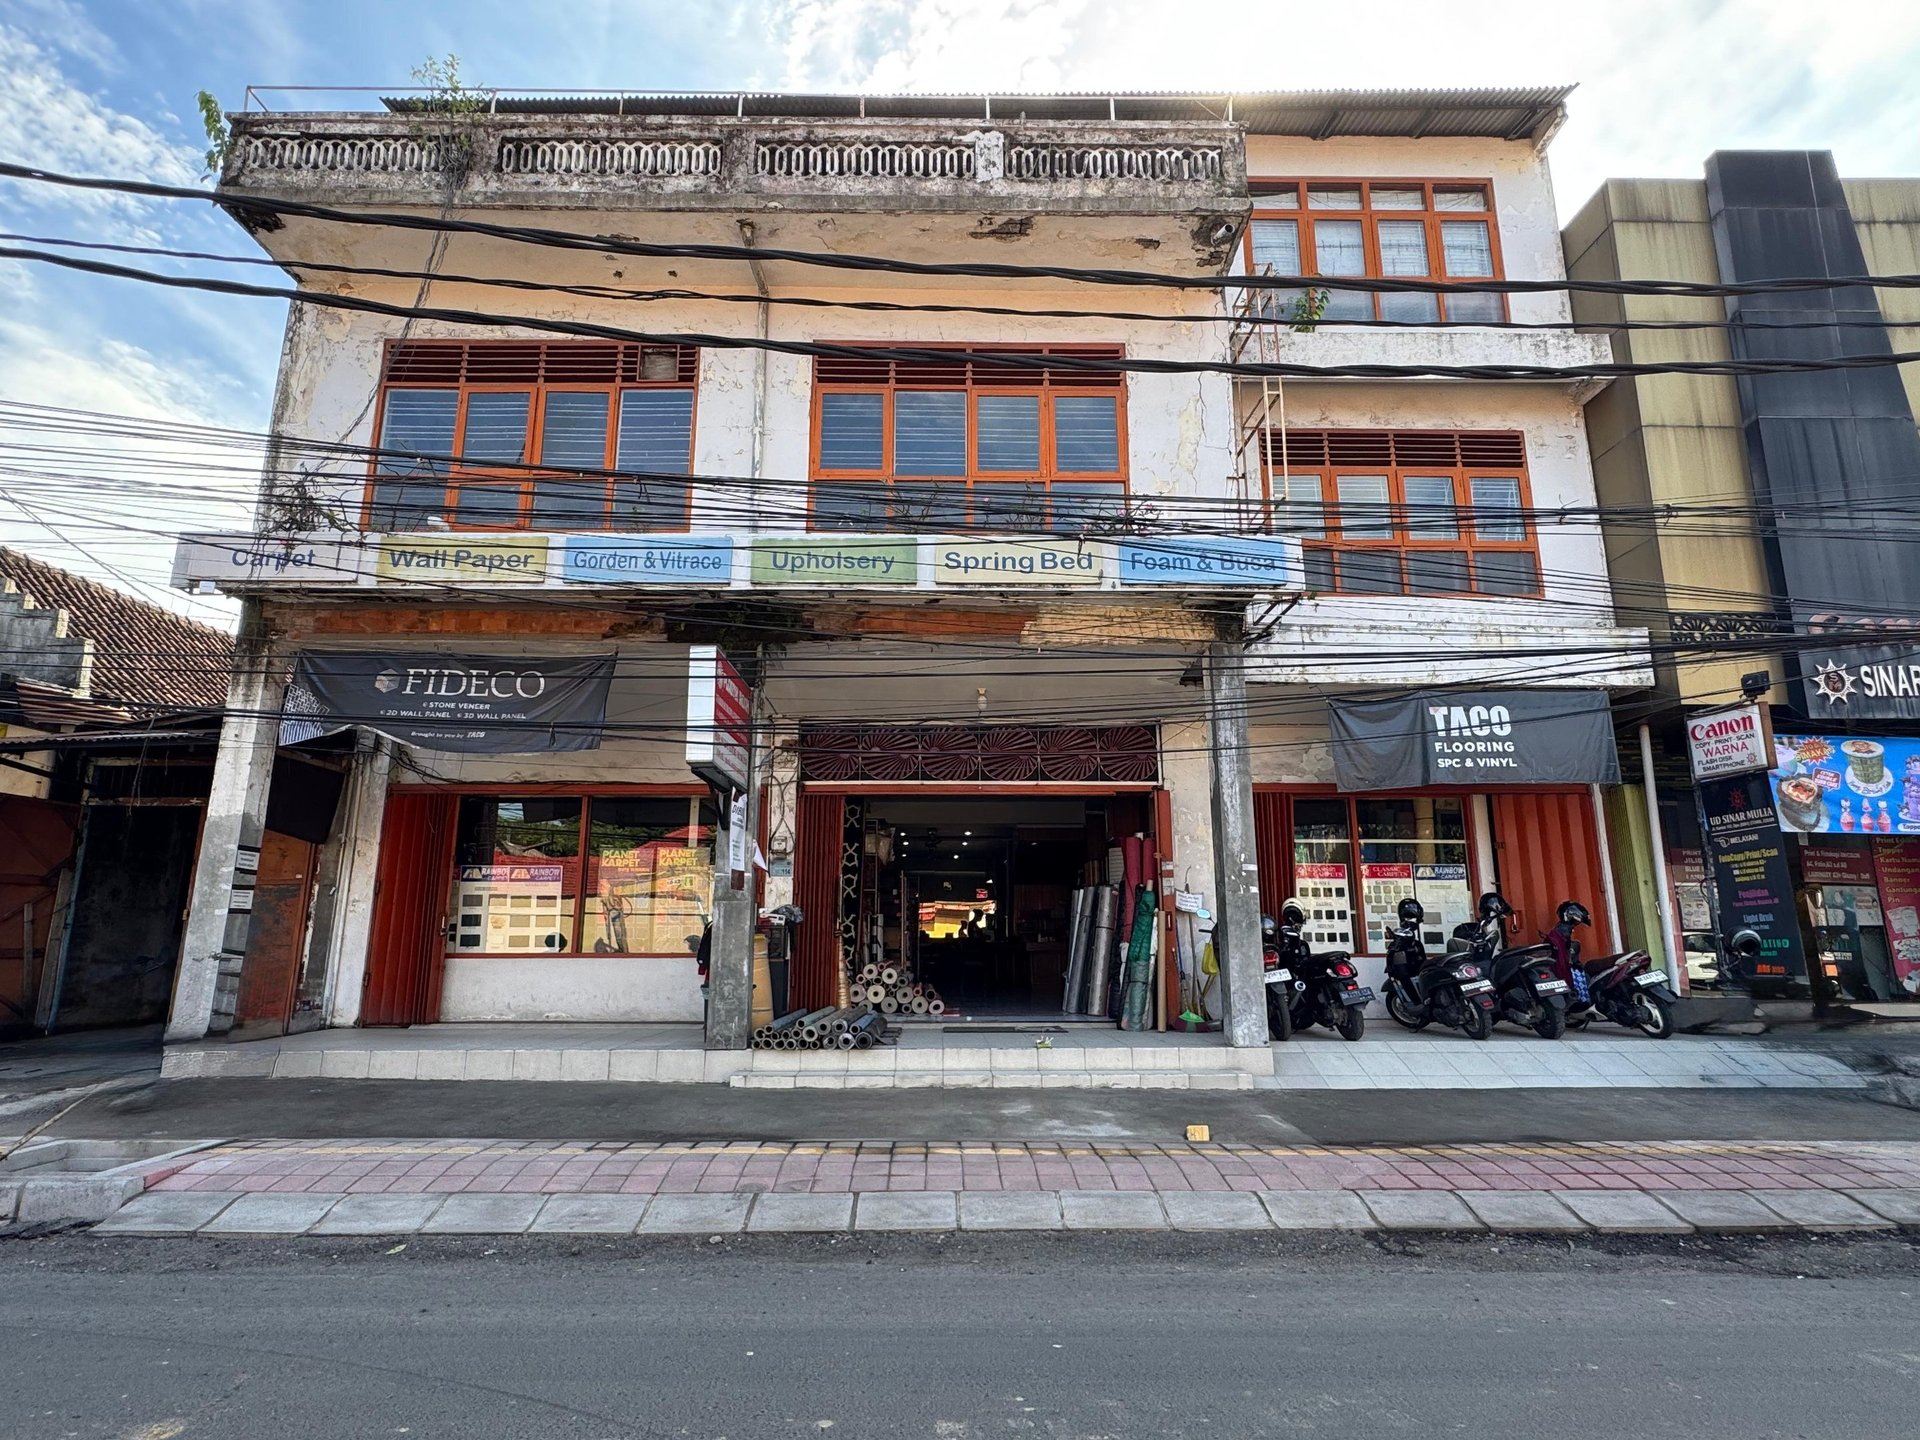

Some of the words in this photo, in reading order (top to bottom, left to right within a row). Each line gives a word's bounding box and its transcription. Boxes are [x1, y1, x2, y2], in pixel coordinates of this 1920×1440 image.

[232, 548, 316, 572] Carpet
[390, 548, 447, 569] Wall
[454, 548, 536, 574] Paper
[574, 550, 639, 570] Gorden
[643, 551, 657, 570] &
[661, 550, 723, 570] Vitrace
[772, 550, 895, 574] Upholsery
[944, 551, 1034, 574] Spring
[1040, 551, 1093, 571] Bed
[1131, 552, 1185, 571] Foam
[1196, 551, 1213, 571] &
[1220, 552, 1277, 572] Busa
[401, 668, 546, 699] FIDECO
[1860, 664, 1920, 698] SINAR
[1428, 705, 1512, 737] TACO
[1690, 714, 1754, 741] Canon
[1434, 741, 1515, 753] FLOORING
[1694, 741, 1711, 750] COPY
[1714, 736, 1733, 745] PRINT
[1735, 732, 1755, 742] SCAN
[1702, 741, 1749, 758] WARNA
[1437, 758, 1462, 768] SPC
[1464, 758, 1474, 767] &
[1476, 757, 1518, 767] VINYL
[1697, 758, 1718, 767] FLASH
[1718, 755, 1733, 763] DISK
[1702, 760, 1746, 773] SMARTPHONE
[1709, 815, 1721, 826] UD
[1722, 811, 1746, 824] SINAR
[1745, 807, 1774, 820] MULIA
[1730, 833, 1759, 844] MELAYANI
[602, 850, 640, 859] PLANET
[659, 849, 697, 858] PLANET
[659, 858, 698, 866] KARPET
[601, 859, 641, 867] KARPET
[1434, 866, 1465, 874] RAINBOW
[529, 868, 560, 876] RAINBOW
